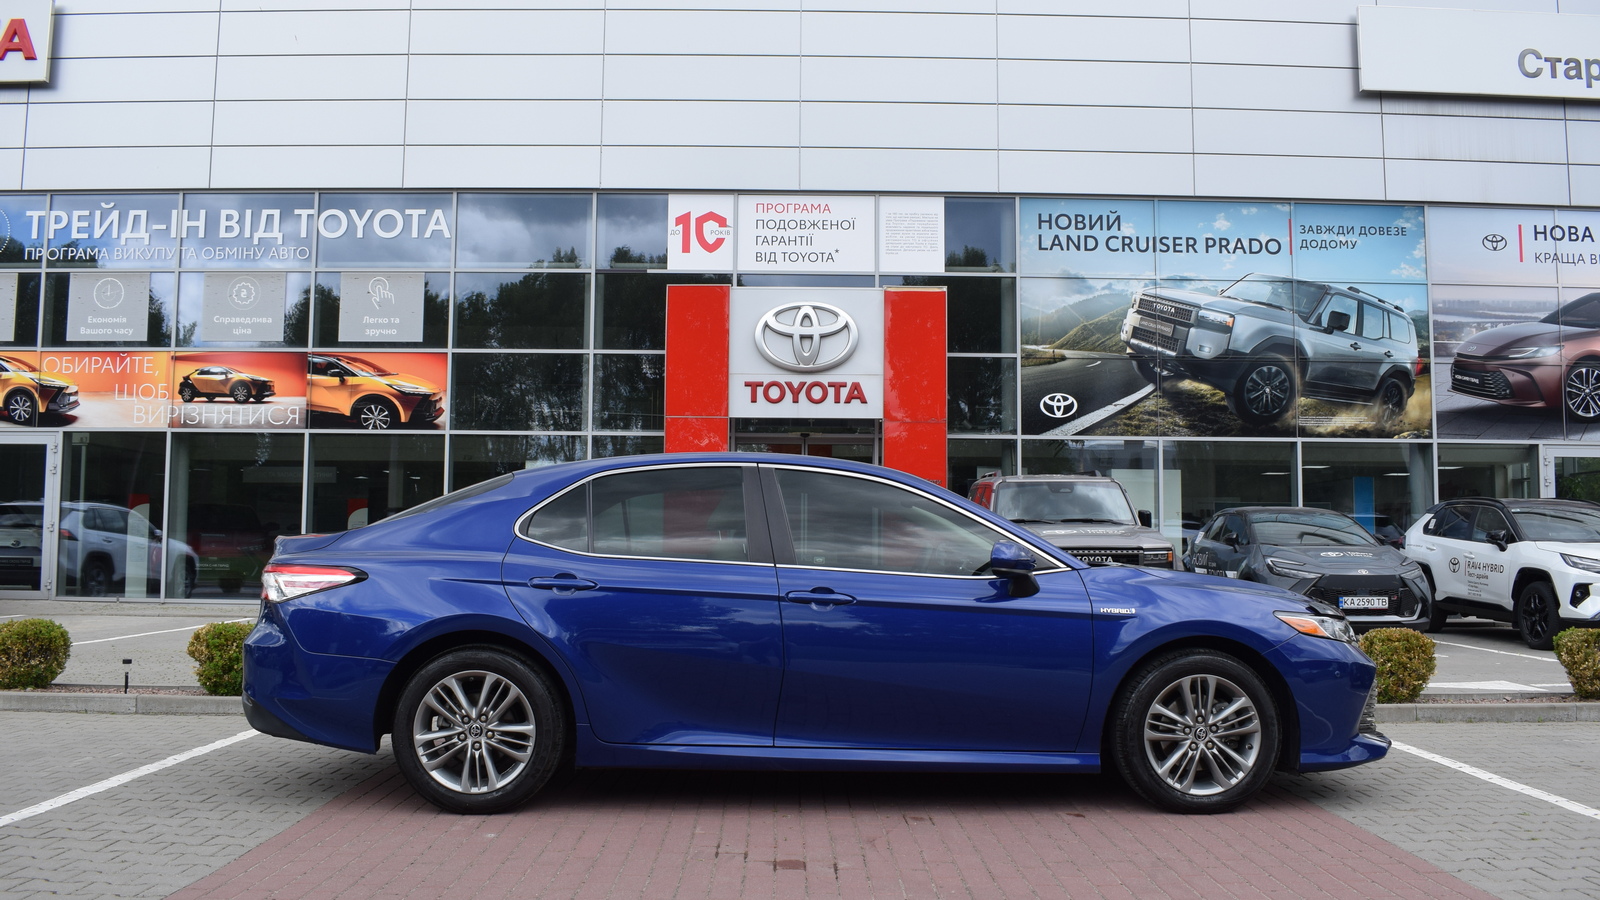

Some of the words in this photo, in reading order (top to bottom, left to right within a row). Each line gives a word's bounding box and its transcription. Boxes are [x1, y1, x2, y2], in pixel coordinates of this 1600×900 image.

[1517, 48, 1600, 89] Стар
[755, 203, 832, 214] ПРОГРАМА
[25, 202, 207, 246] ТРЕЙД-ІН
[219, 208, 283, 245] ВІД
[294, 208, 451, 239] TOYOTA
[755, 217, 856, 232] ПОДОВЖЕНОЇ
[1037, 210, 1122, 232] НОВИЙ
[669, 229, 681, 237] ДО
[1299, 224, 1355, 237] ЗАВЖДИ
[1358, 225, 1407, 238] ДОВЕЗЕ
[1533, 224, 1595, 243] НОВА
[755, 233, 814, 247] ГАРАНТІЇ
[1037, 233, 1099, 252] LAND
[1104, 234, 1198, 254] CRUISER
[1204, 237, 1282, 256] PRADO
[1299, 239, 1358, 251] ДОДОМУ
[24, 247, 109, 261] ПРОГРАМА
[114, 246, 176, 261] ВИКУПУ
[180, 246, 198, 260] ТА
[201, 246, 265, 261] ОБМІНУ
[268, 246, 310, 260] АВТО
[755, 252, 778, 264] ВІД
[1534, 252, 1586, 267] КРАЩА
[1590, 253, 1600, 265] В
[1152, 303, 1175, 313] TOYOTA
[87, 315, 127, 324] Економія
[213, 315, 273, 326] Справедлива
[362, 315, 389, 324] Легко
[80, 326, 113, 335] Вашого
[114, 328, 133, 337] часу
[232, 326, 252, 336] ціна
[365, 328, 397, 337] зручно
[43, 353, 159, 377] ОБИРАЙТЕ,
[115, 383, 169, 403] ЩОБ
[743, 380, 869, 404] TOYOTA
[133, 405, 300, 425] ВИРІЗНЯТИСЯ
[1467, 560, 1481, 570] RAV4
[1482, 562, 1505, 574] HYBRID
[1343, 598, 1355, 606] KA
[1356, 598, 1375, 606] 2590
[1376, 598, 1388, 606] TB
